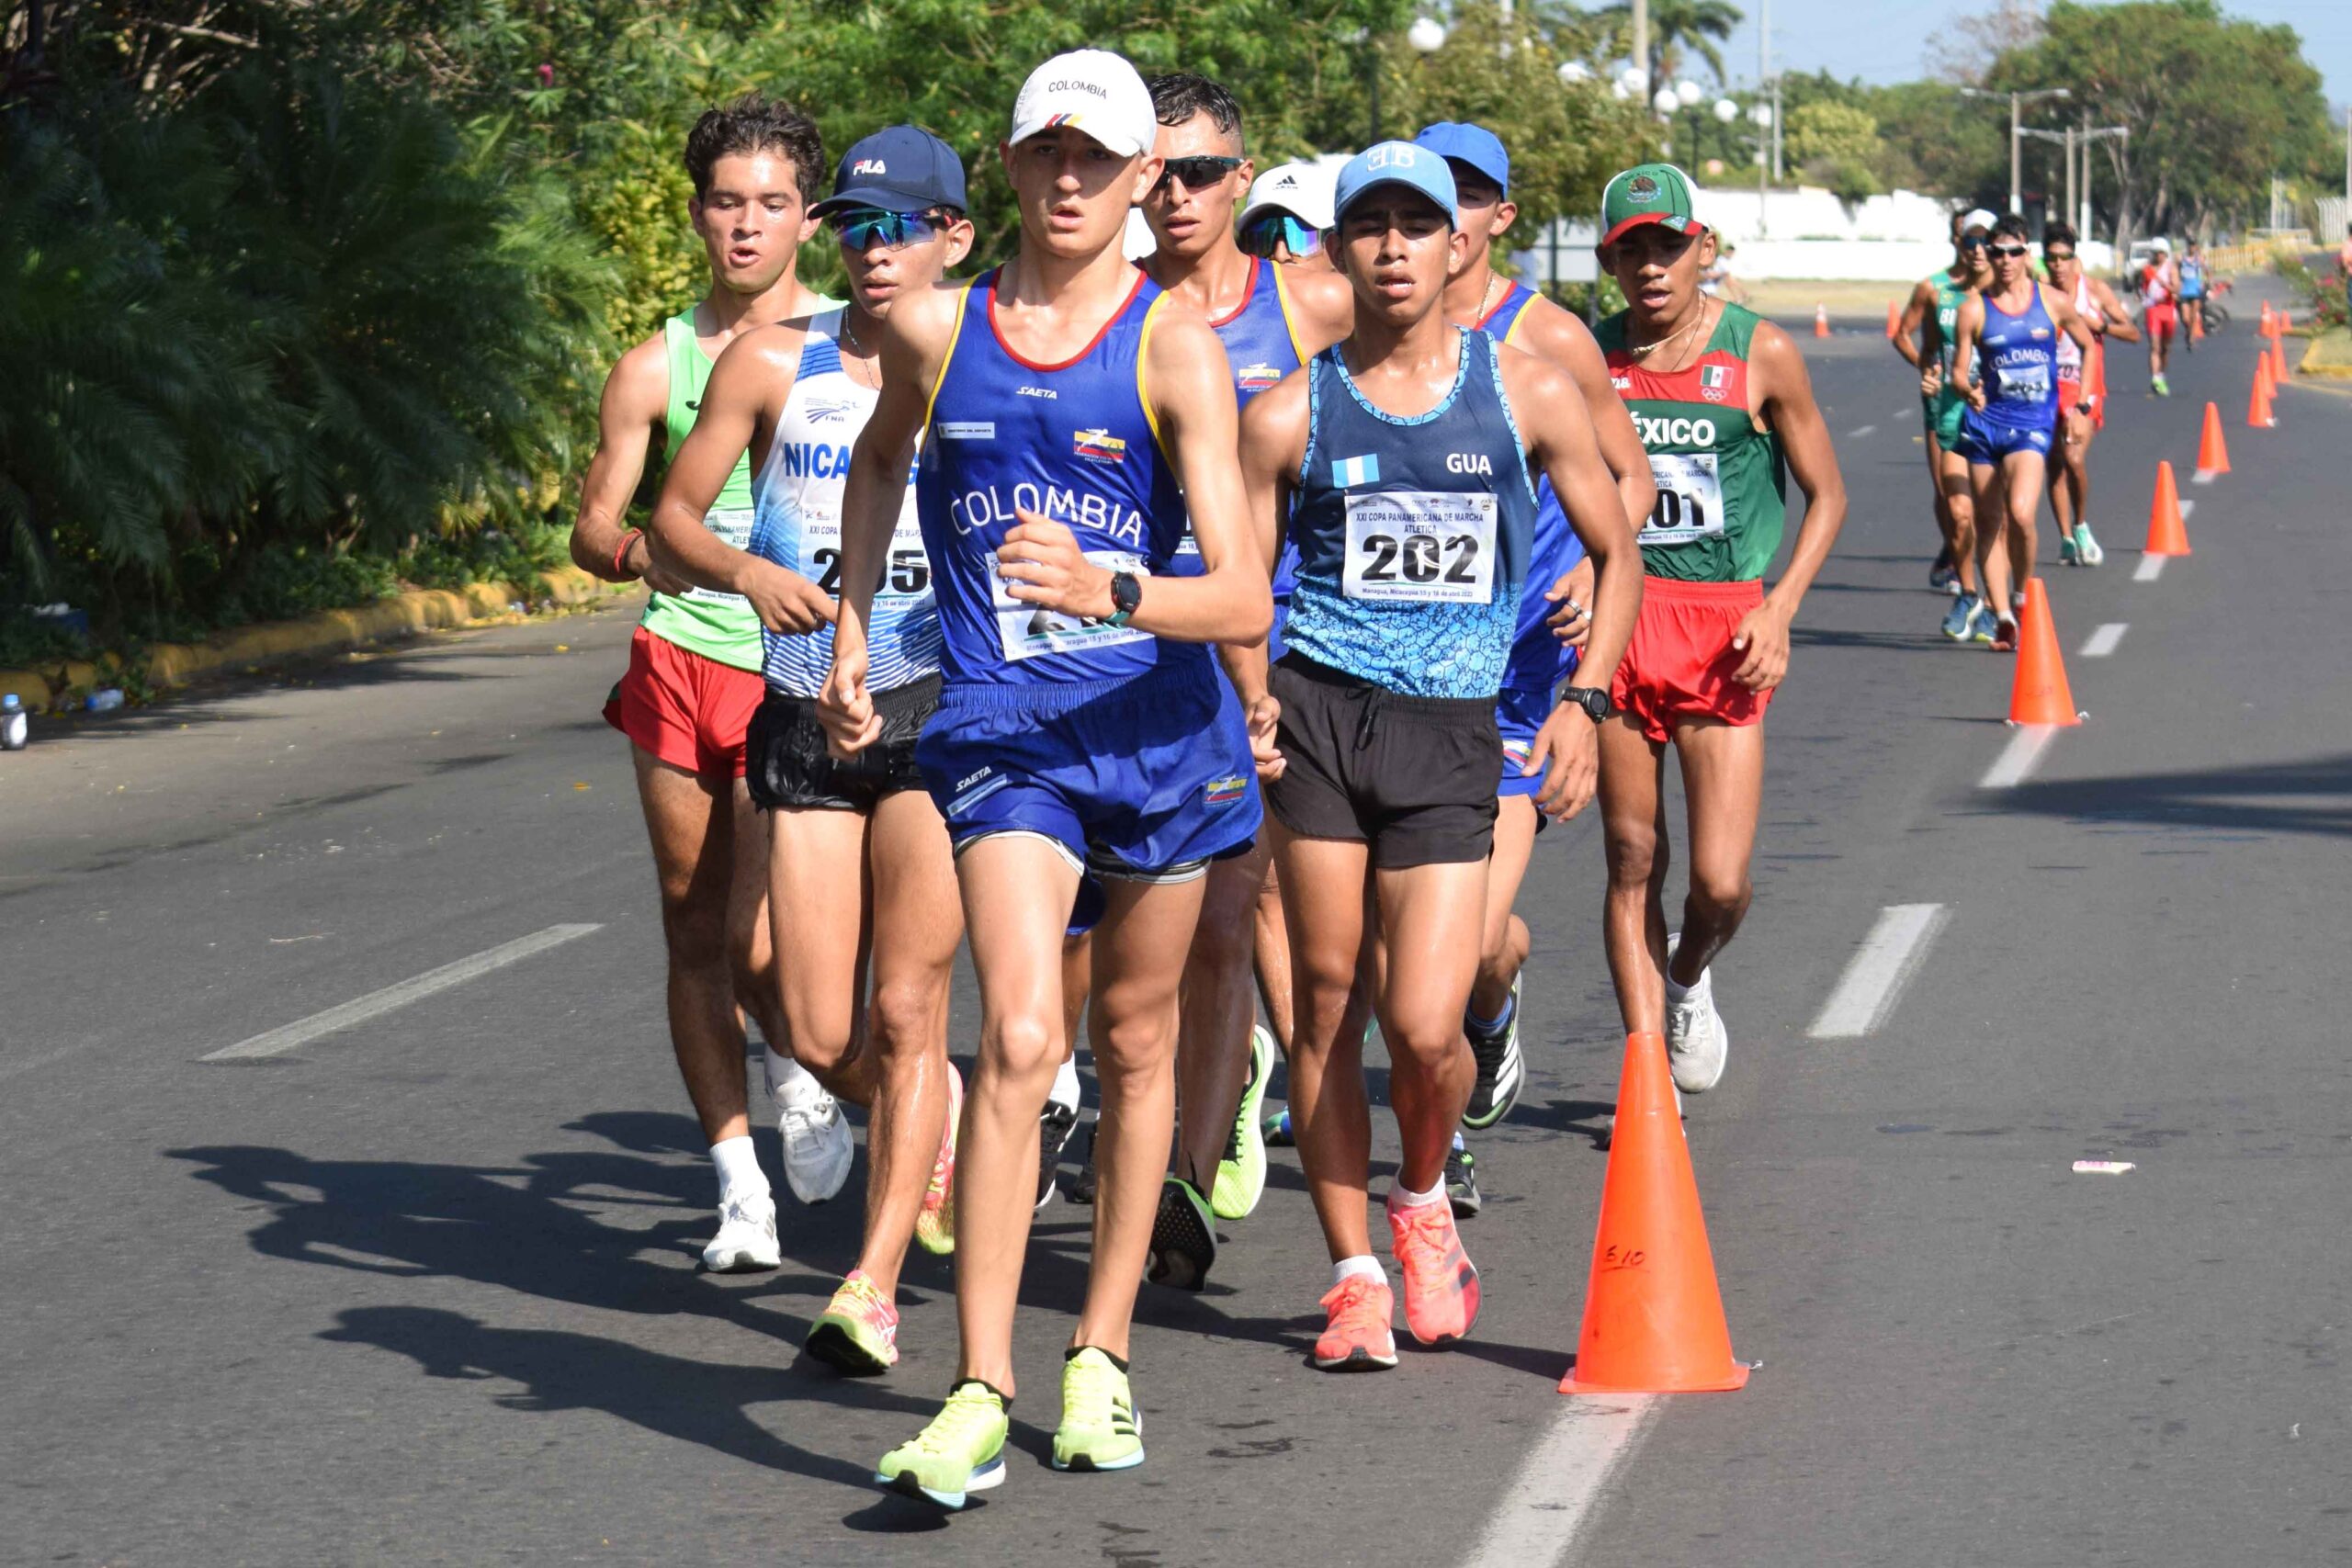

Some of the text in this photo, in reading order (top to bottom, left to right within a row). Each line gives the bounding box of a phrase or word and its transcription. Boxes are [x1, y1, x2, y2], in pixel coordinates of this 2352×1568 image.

[1048, 80, 1107, 99] COLOMBIA
[853, 159, 886, 176] FILA
[1016, 386, 1057, 400] SAETA
[1630, 412, 1716, 447] ÉXICO
[1446, 453, 1493, 475] GUA
[1657, 479, 1672, 488] ETICA
[951, 483, 1142, 547] COLOMBIA
[1356, 512, 1484, 523] XXI COPA PANAMERICANA DE MARCHA
[809, 525, 820, 535] XXI
[820, 526, 838, 536] COPA
[895, 529, 904, 537] DE
[1404, 525, 1438, 534] ATLETICA
[1362, 535, 1479, 583] 202
[814, 548, 929, 593] 25
[956, 765, 992, 792] SAETA
